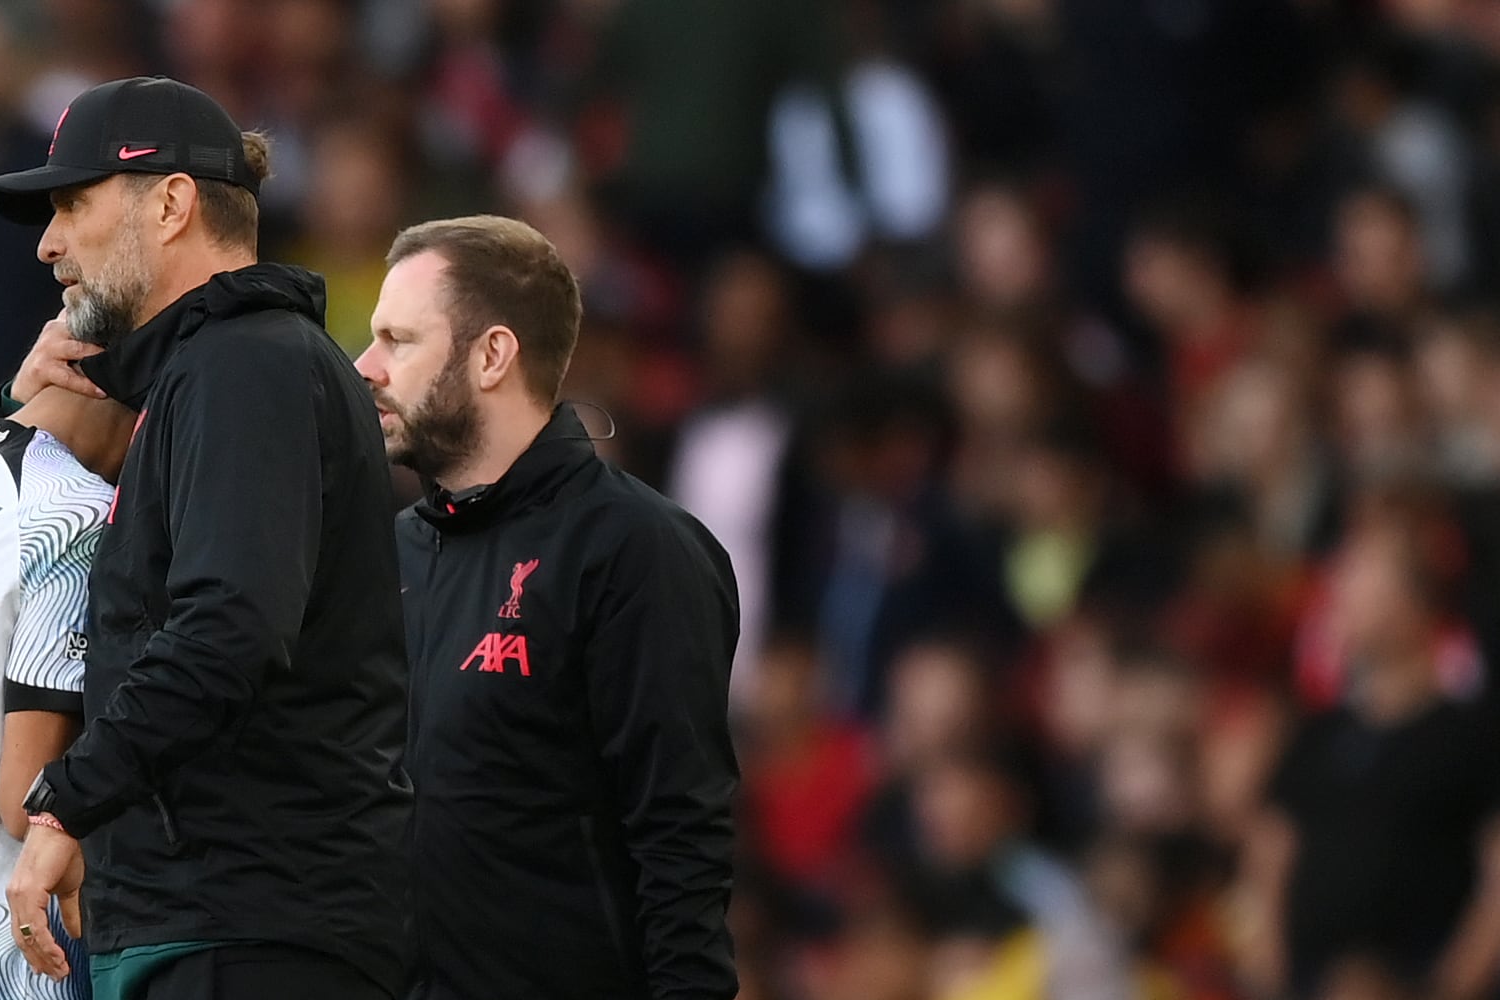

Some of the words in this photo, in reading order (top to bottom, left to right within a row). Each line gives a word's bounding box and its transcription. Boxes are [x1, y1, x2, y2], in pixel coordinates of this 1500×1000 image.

[497, 605, 521, 618] LFC
[67, 631, 88, 649] No
[459, 632, 532, 676] AXA
